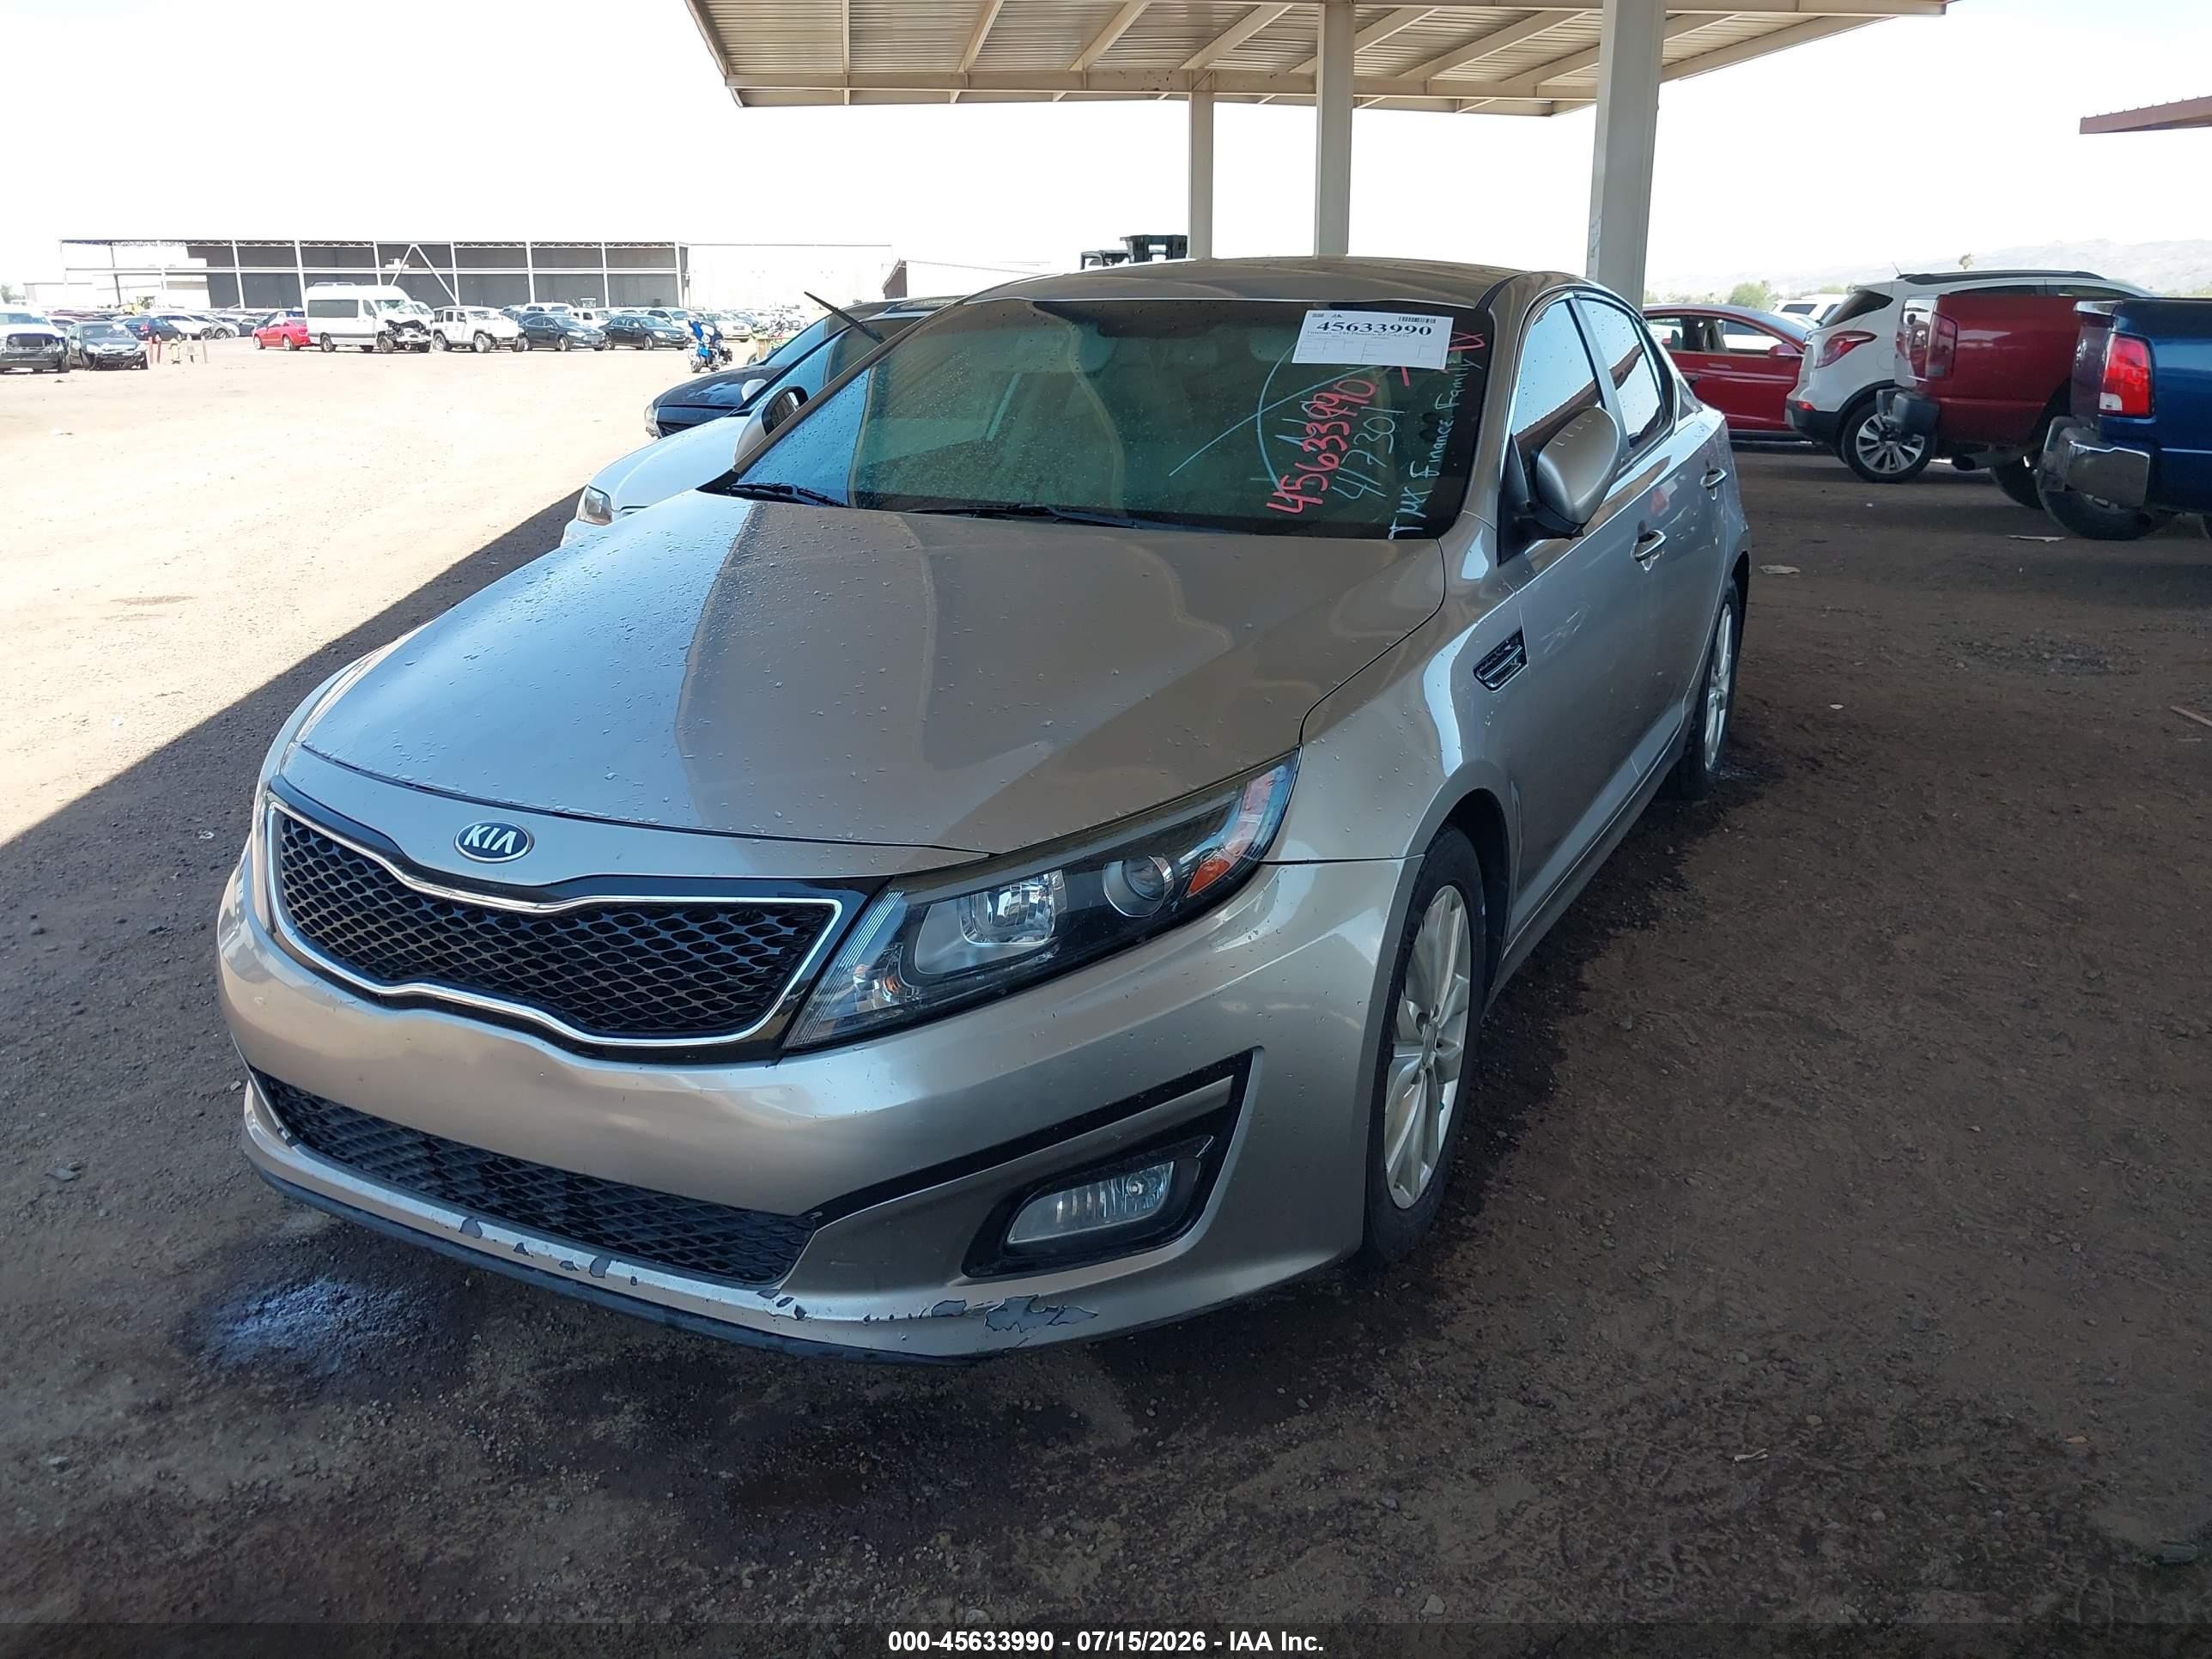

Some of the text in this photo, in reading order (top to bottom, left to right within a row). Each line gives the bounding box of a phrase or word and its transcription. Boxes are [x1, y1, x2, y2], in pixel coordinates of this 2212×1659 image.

[1316, 321, 1432, 337] 45633990
[1267, 379, 1376, 514] 45633990
[463, 824, 518, 854] KIA
